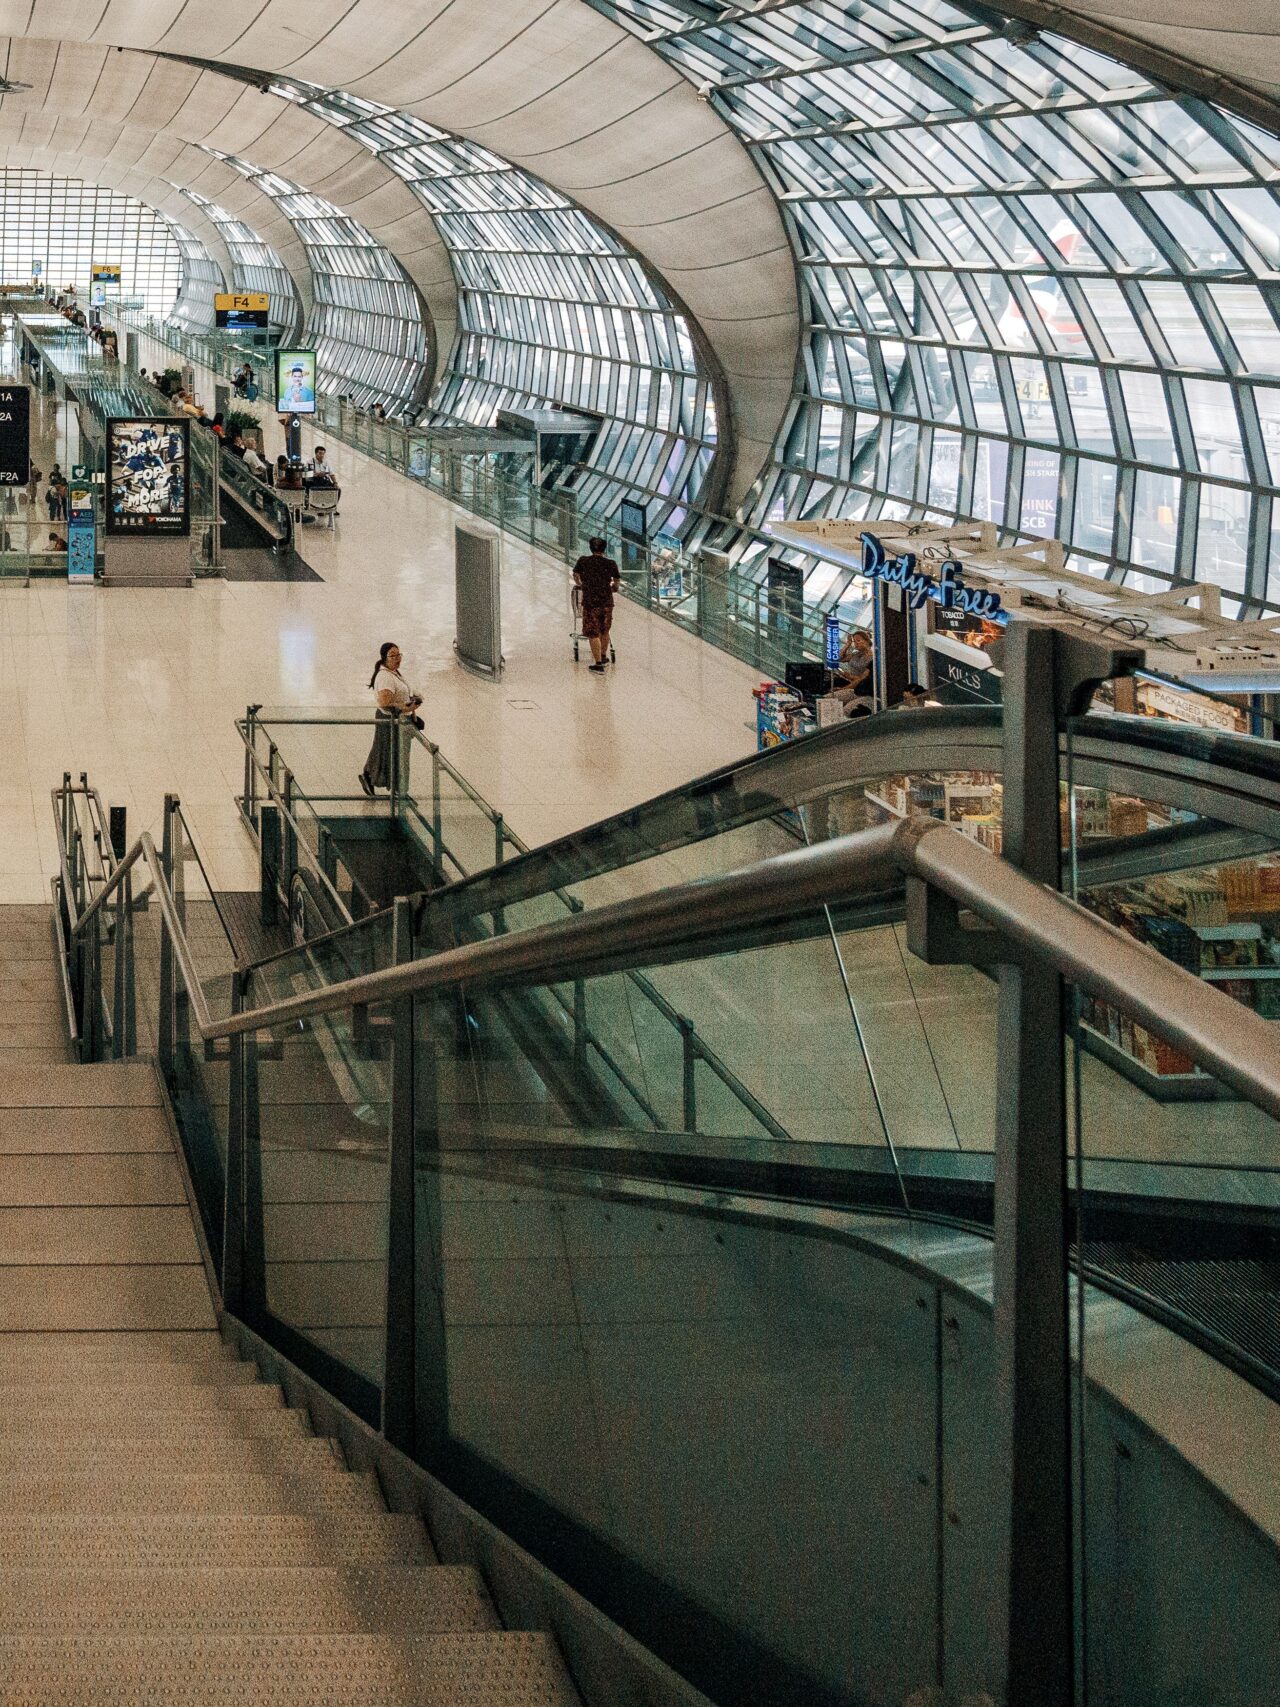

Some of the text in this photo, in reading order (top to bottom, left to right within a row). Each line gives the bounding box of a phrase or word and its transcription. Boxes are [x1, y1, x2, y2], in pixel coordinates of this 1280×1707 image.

[233, 296, 250, 308] F4
[126, 435, 170, 459] DRIVE
[128, 486, 170, 507] MORE
[1021, 499, 1055, 511] HINK
[1021, 516, 1047, 529] SCB
[860, 532, 1001, 619] Duty Free
[941, 611, 965, 619] TOBACCO
[948, 664, 981, 690] KILLS
[1154, 691, 1201, 716] PACKAGED
[1202, 710, 1229, 727] FOOD
